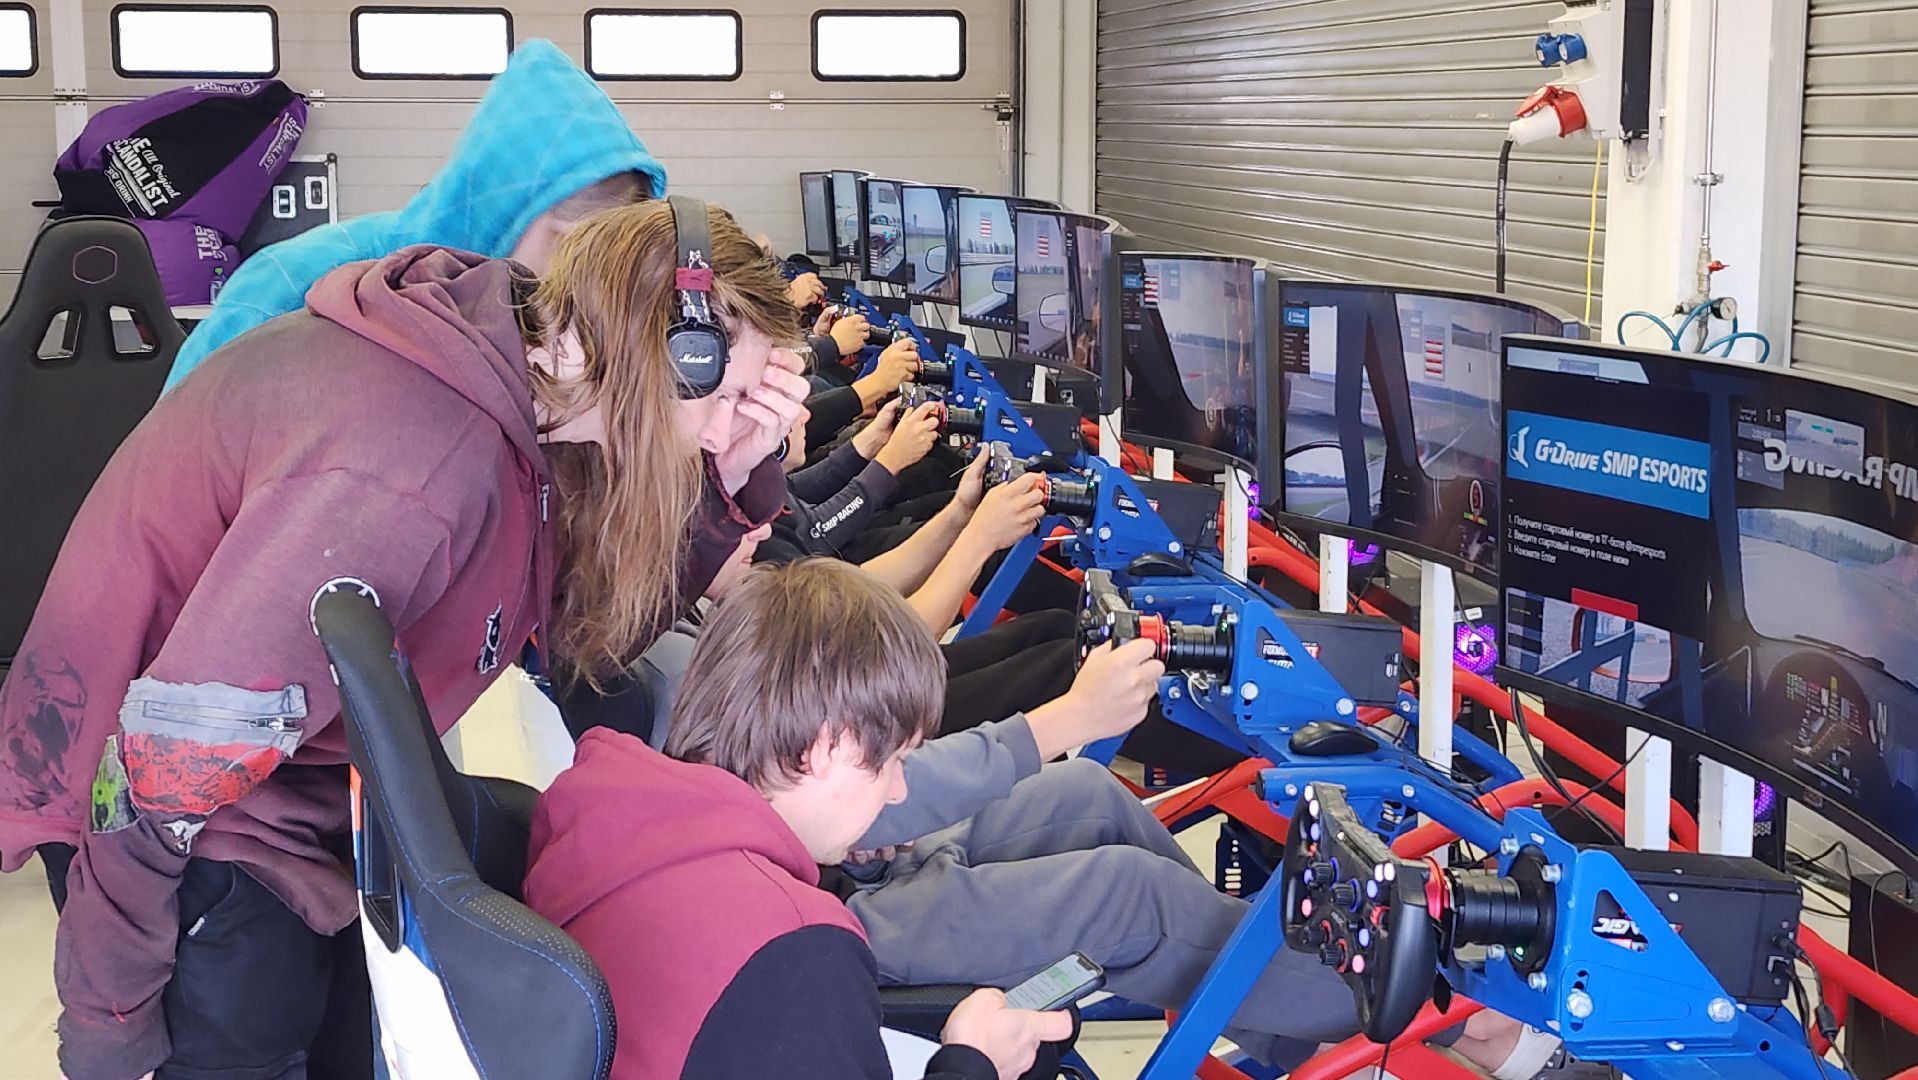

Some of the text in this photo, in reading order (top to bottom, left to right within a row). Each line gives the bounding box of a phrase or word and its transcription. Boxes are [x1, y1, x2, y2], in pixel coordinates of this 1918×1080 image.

[113, 139, 168, 207] SCANDALIST
[152, 164, 181, 199] Original
[1602, 450, 1639, 478] SMP
[1640, 457, 1707, 494] ESPORTS
[822, 496, 864, 532] SMP RACING
